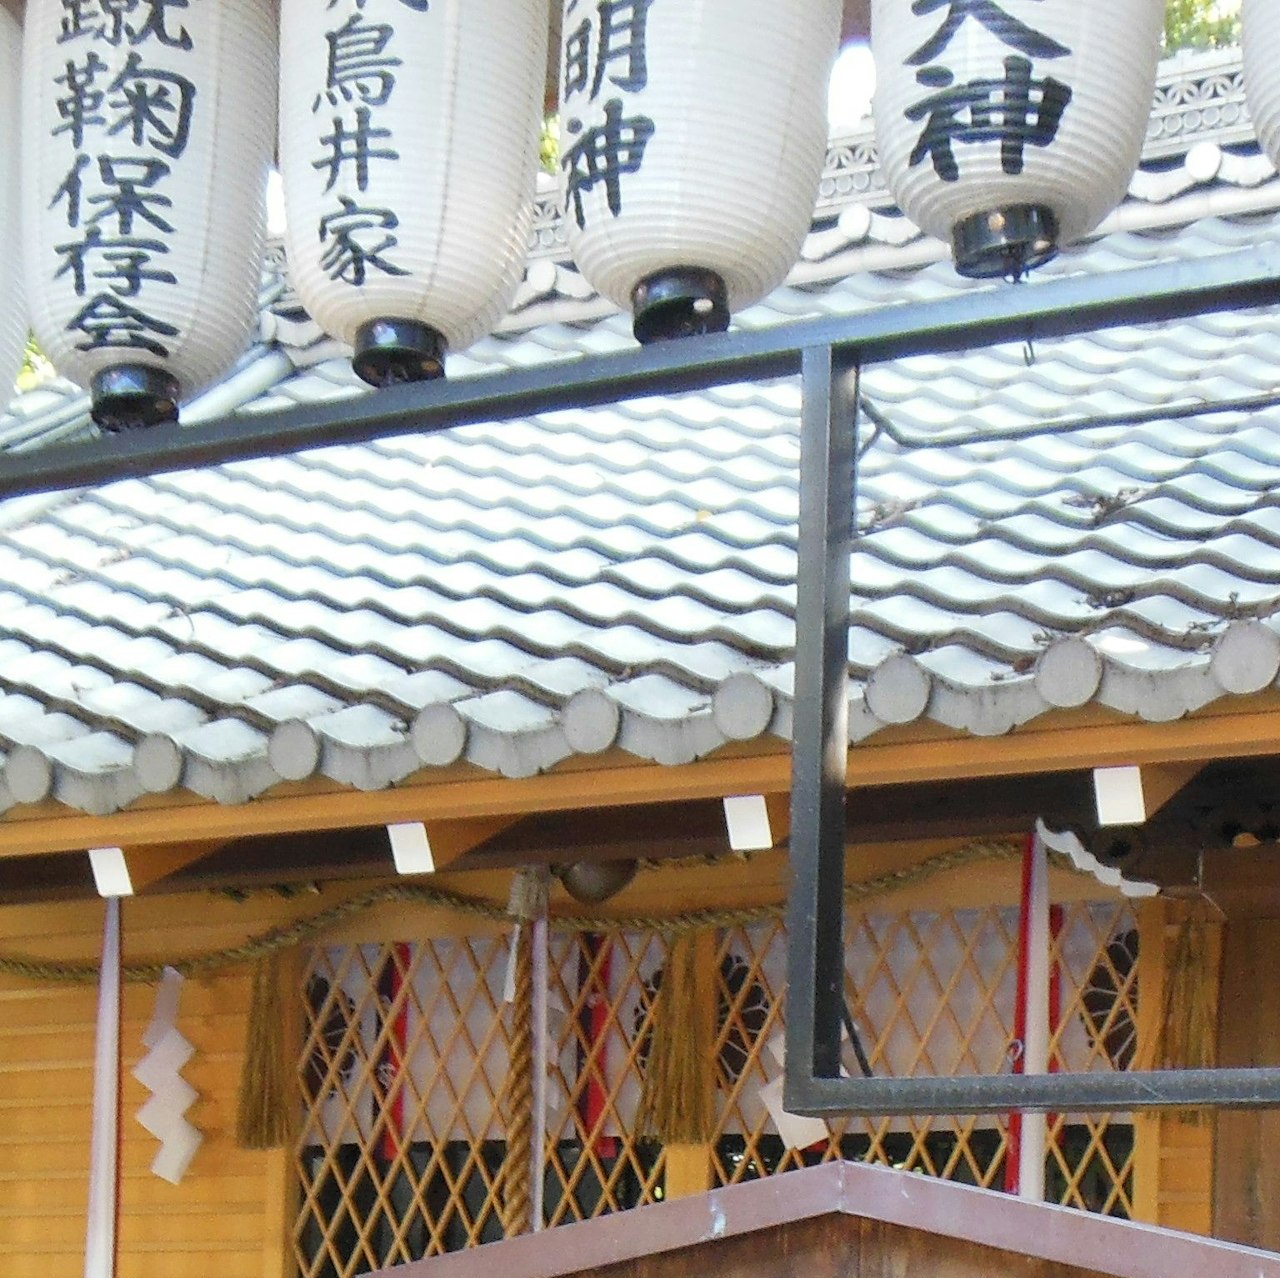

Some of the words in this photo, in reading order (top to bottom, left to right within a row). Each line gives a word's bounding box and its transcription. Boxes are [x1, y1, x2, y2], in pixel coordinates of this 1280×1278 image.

[311, 0, 431, 286] 鳥井家
[561, 0, 656, 231] 明神
